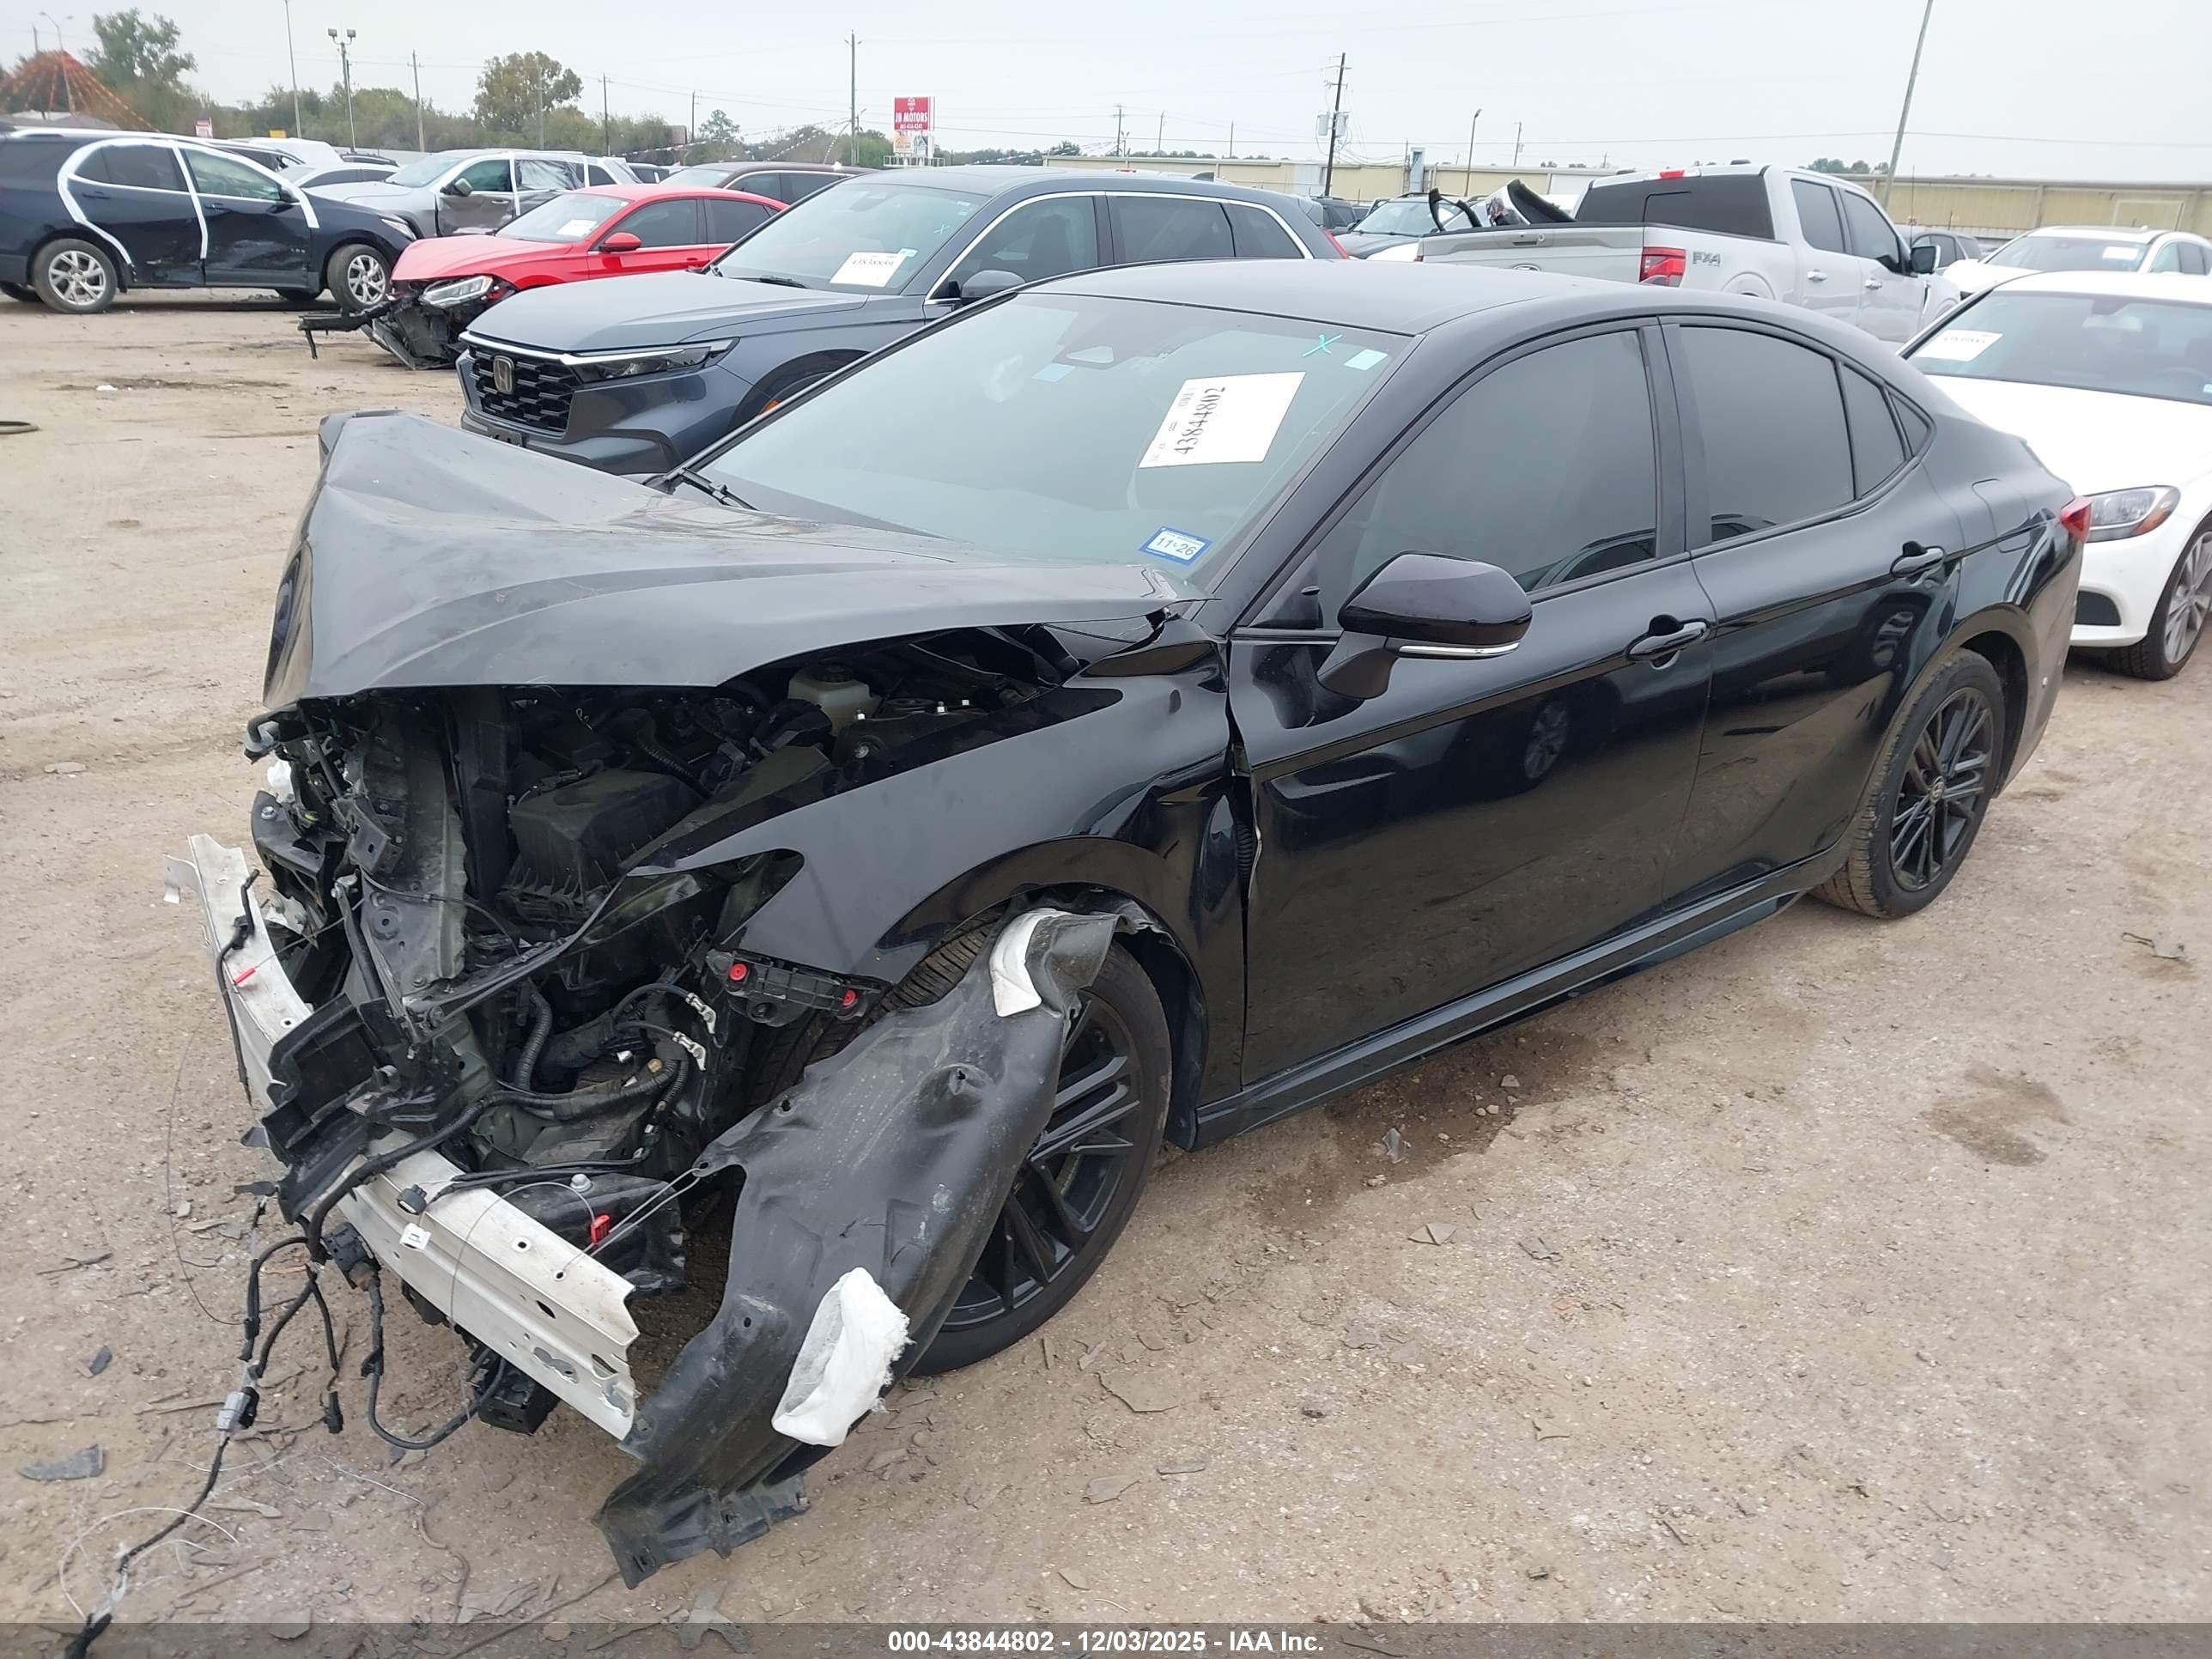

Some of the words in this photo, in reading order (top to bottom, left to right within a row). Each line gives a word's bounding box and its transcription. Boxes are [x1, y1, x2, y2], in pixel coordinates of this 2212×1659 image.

[903, 112, 928, 123] MOTORS
[1692, 252, 1721, 264] FX4
[1174, 386, 1226, 455] 43844802
